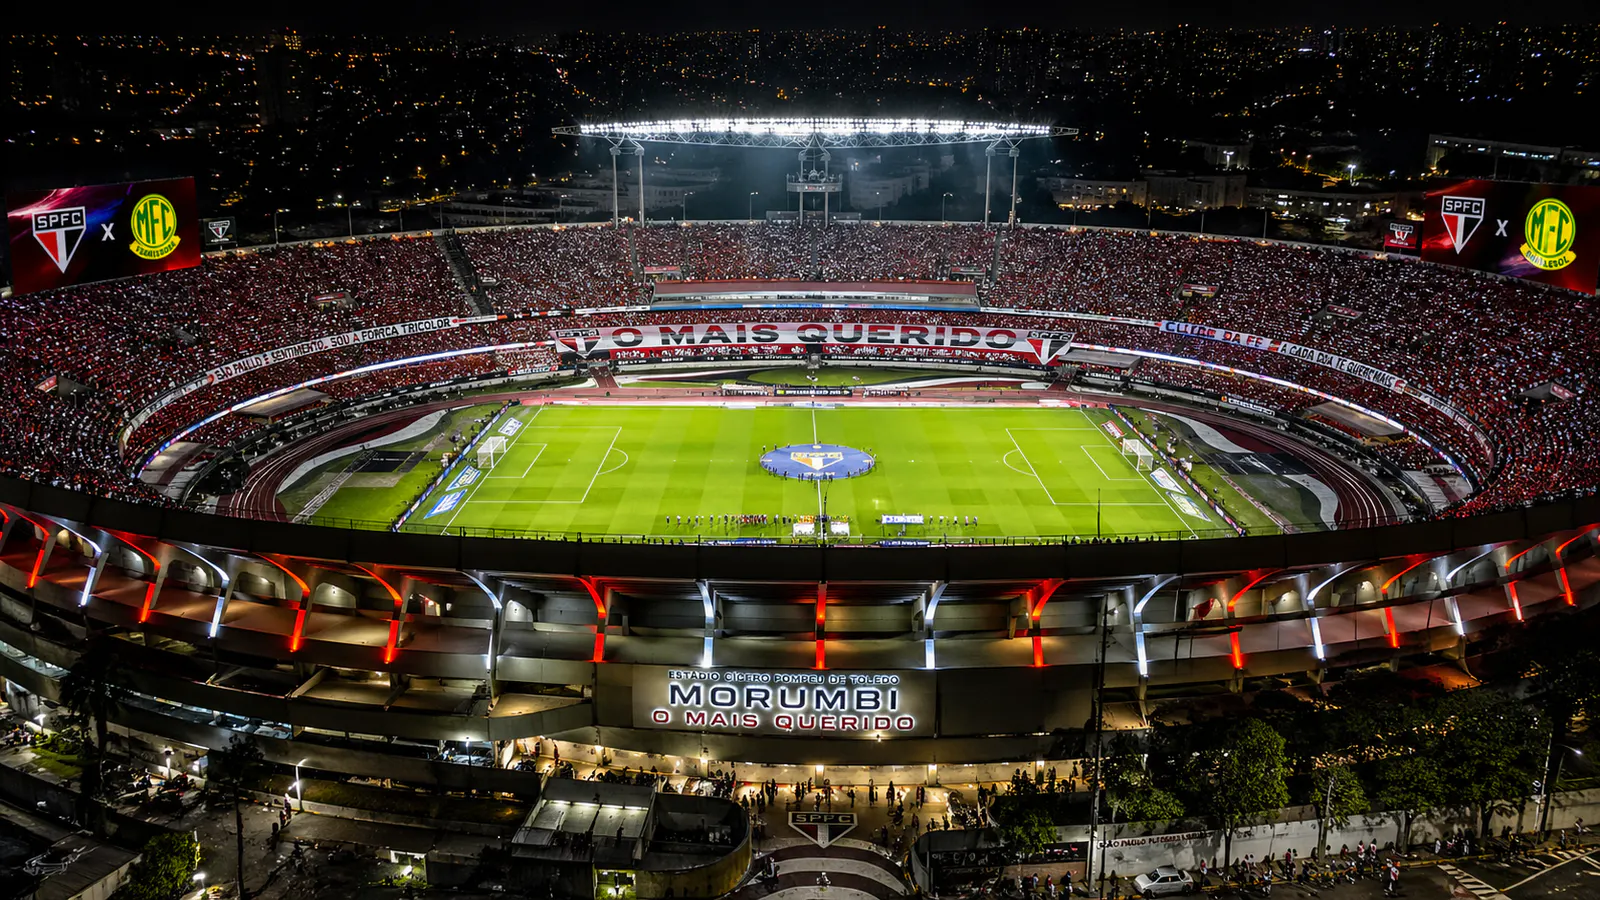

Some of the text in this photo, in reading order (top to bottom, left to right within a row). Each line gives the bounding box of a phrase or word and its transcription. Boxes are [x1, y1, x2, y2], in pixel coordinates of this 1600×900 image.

[1444, 199, 1482, 214] SPFC
[36, 211, 82, 229] SPFC
[136, 199, 172, 245] MFC
[330, 334, 350, 348] SOU
[353, 333, 360, 343] A
[401, 318, 451, 334] TRICOLOR
[611, 327, 643, 347] O
[658, 324, 780, 346] MAIS
[797, 324, 1017, 349] QUERIDO
[1280, 343, 1287, 354] A
[1289, 345, 1315, 361] CADA
[1336, 358, 1347, 372] TE
[774, 673, 825, 684] POMPEU
[829, 674, 846, 684] DE
[850, 674, 900, 685] TOLEDO
[669, 684, 898, 710] MORUMBI
[652, 710, 915, 730] O MAIS QUERIDO
